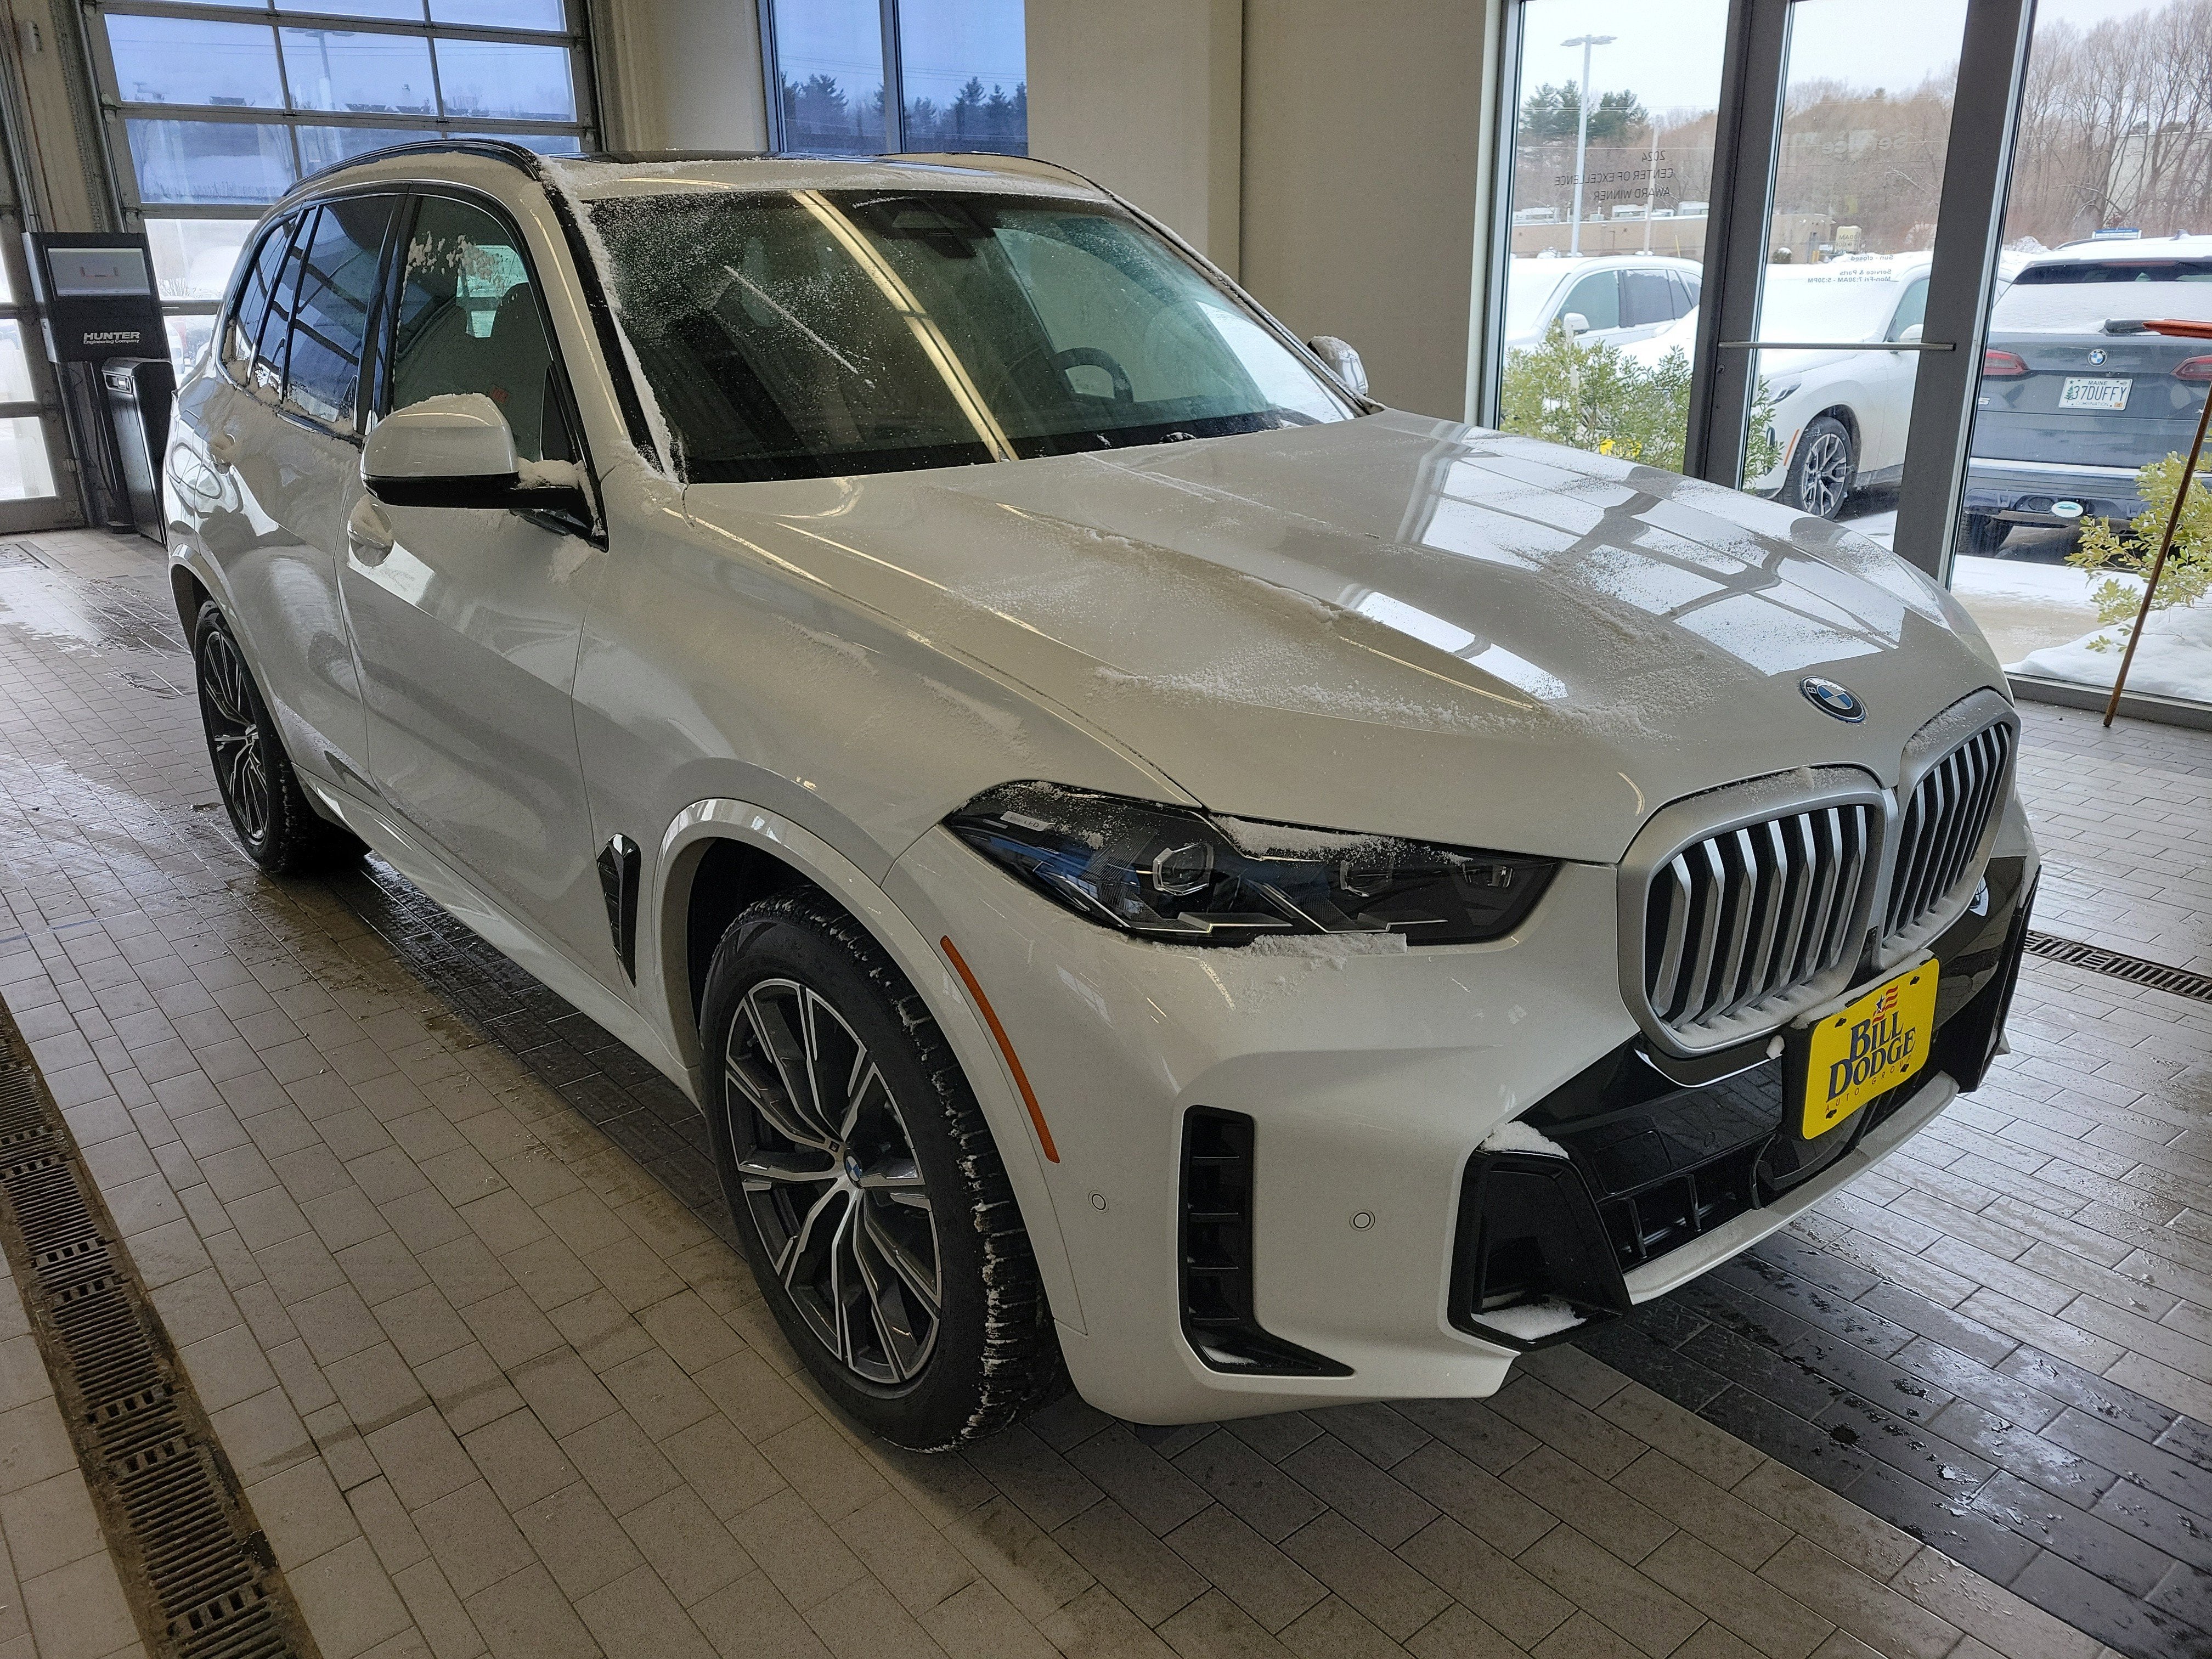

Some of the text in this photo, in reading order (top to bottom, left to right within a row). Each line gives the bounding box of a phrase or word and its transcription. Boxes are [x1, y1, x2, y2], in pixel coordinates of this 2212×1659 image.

[83, 331, 140, 340] HUNTER
[2073, 385, 2128, 402] 37DUFFY
[1849, 1011, 1904, 1063] BILL
[1825, 1055, 1911, 1113] AUTO GROUP
[1826, 1027, 1916, 1103] DODGE
